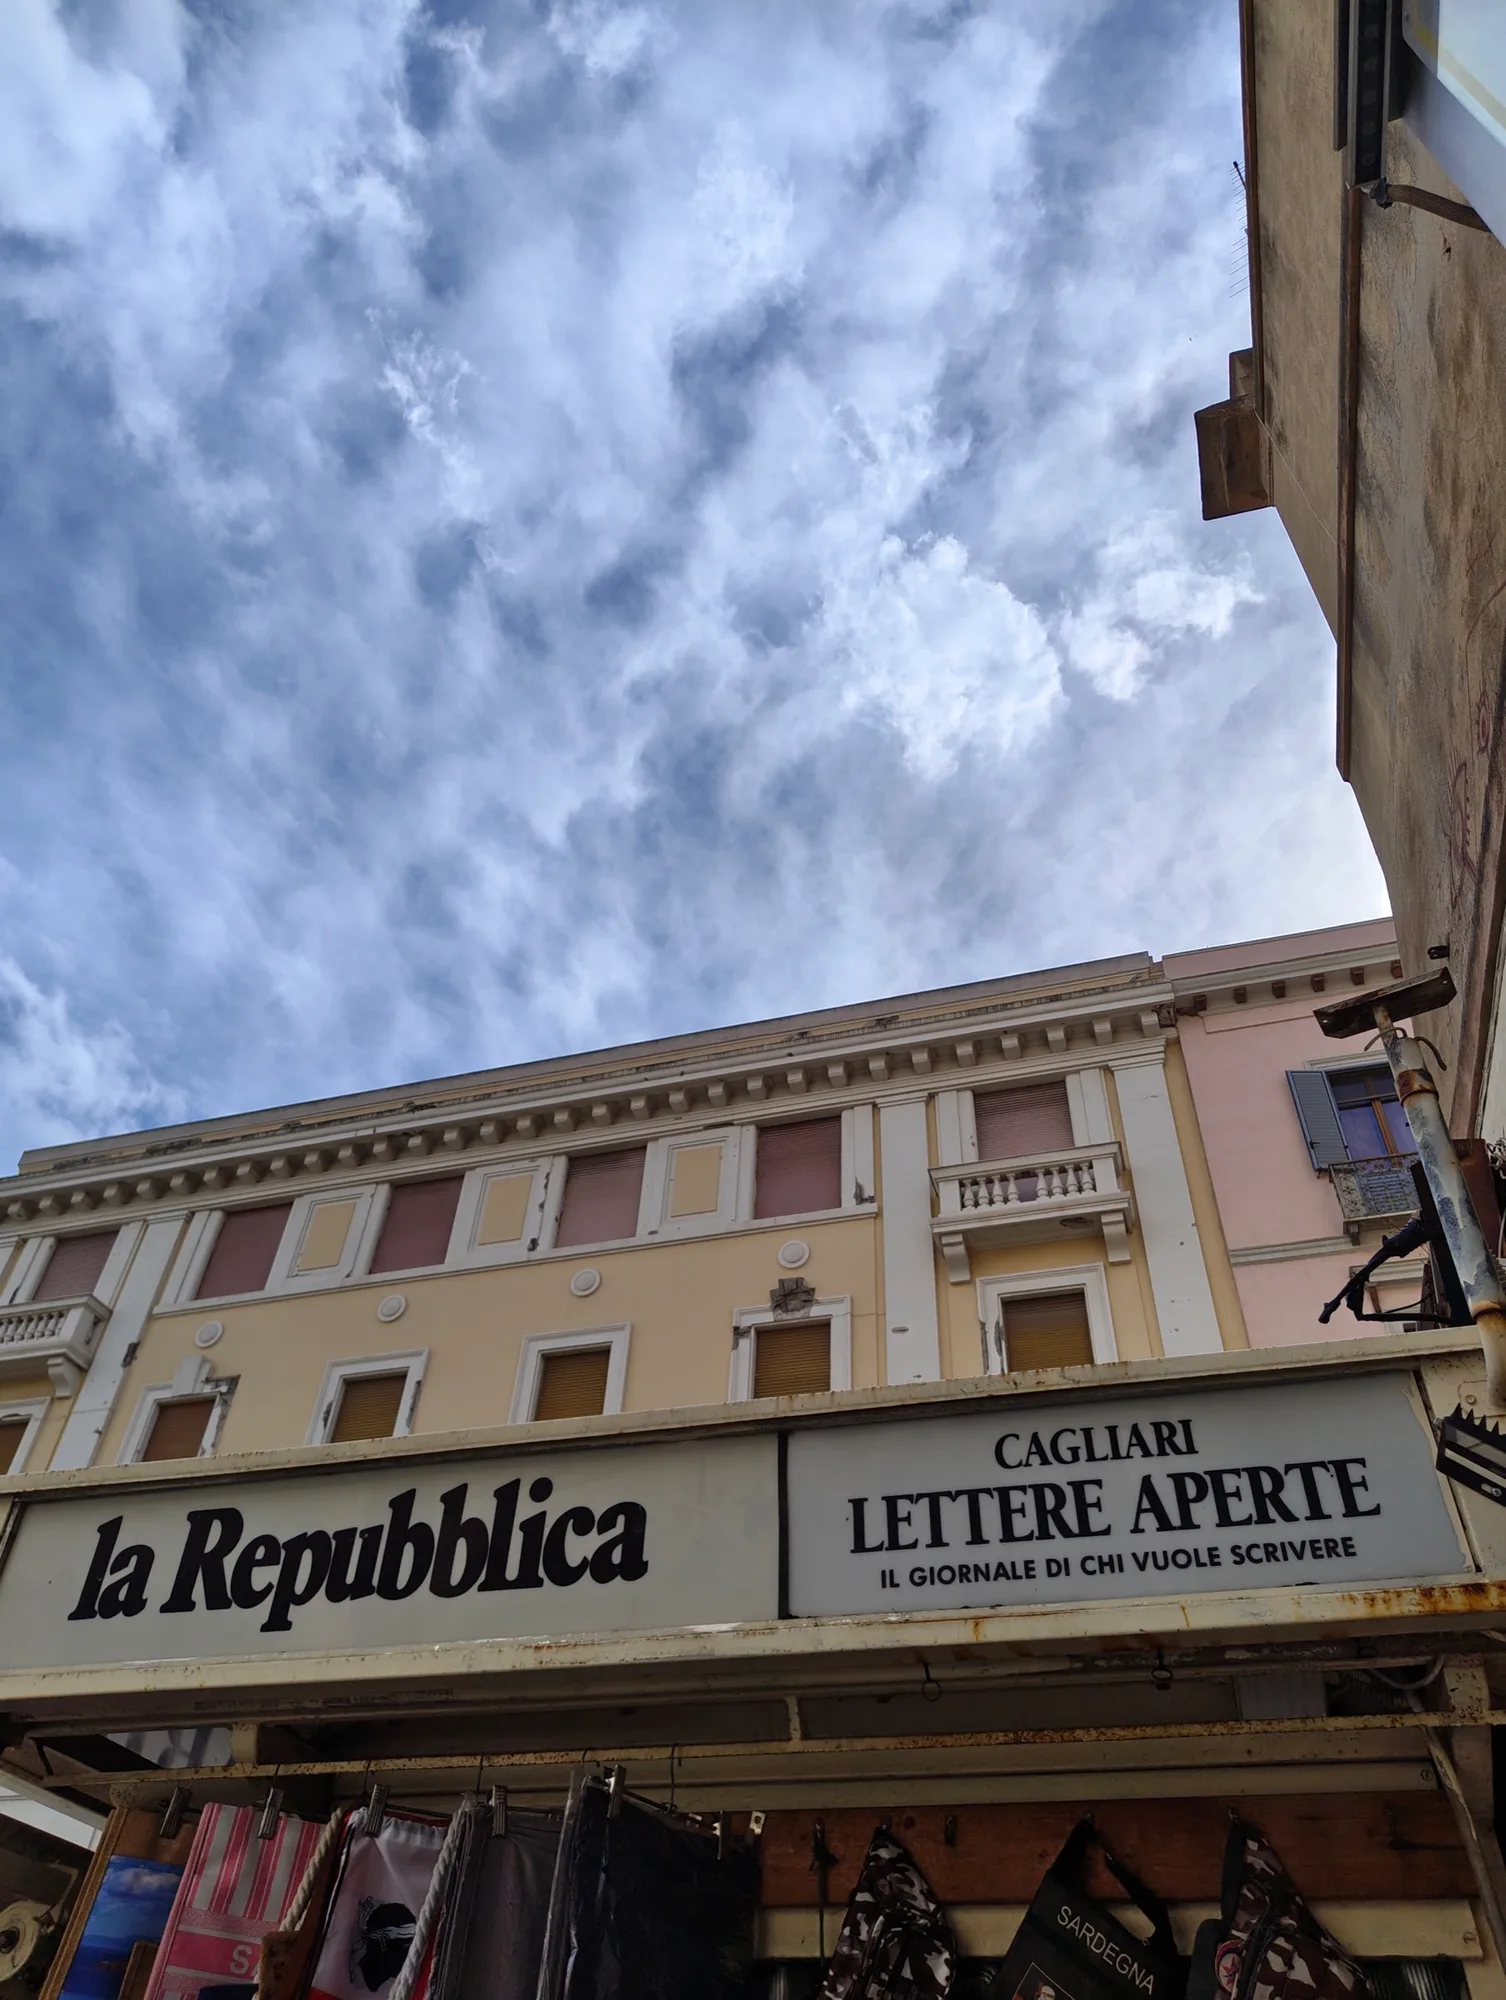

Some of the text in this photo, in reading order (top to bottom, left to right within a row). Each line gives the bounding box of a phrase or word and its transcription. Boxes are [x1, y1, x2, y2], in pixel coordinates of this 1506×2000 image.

[994, 1419, 1199, 1469] CAGLIARI
[848, 1457, 1382, 1555] LETTERE APERTE
[67, 1476, 650, 1633] la Repubblica
[881, 1536, 1359, 1590] IL GIORNALE DI CHI VUOLE SCRIVERE
[1056, 1905, 1156, 1996] SARDEGNA
